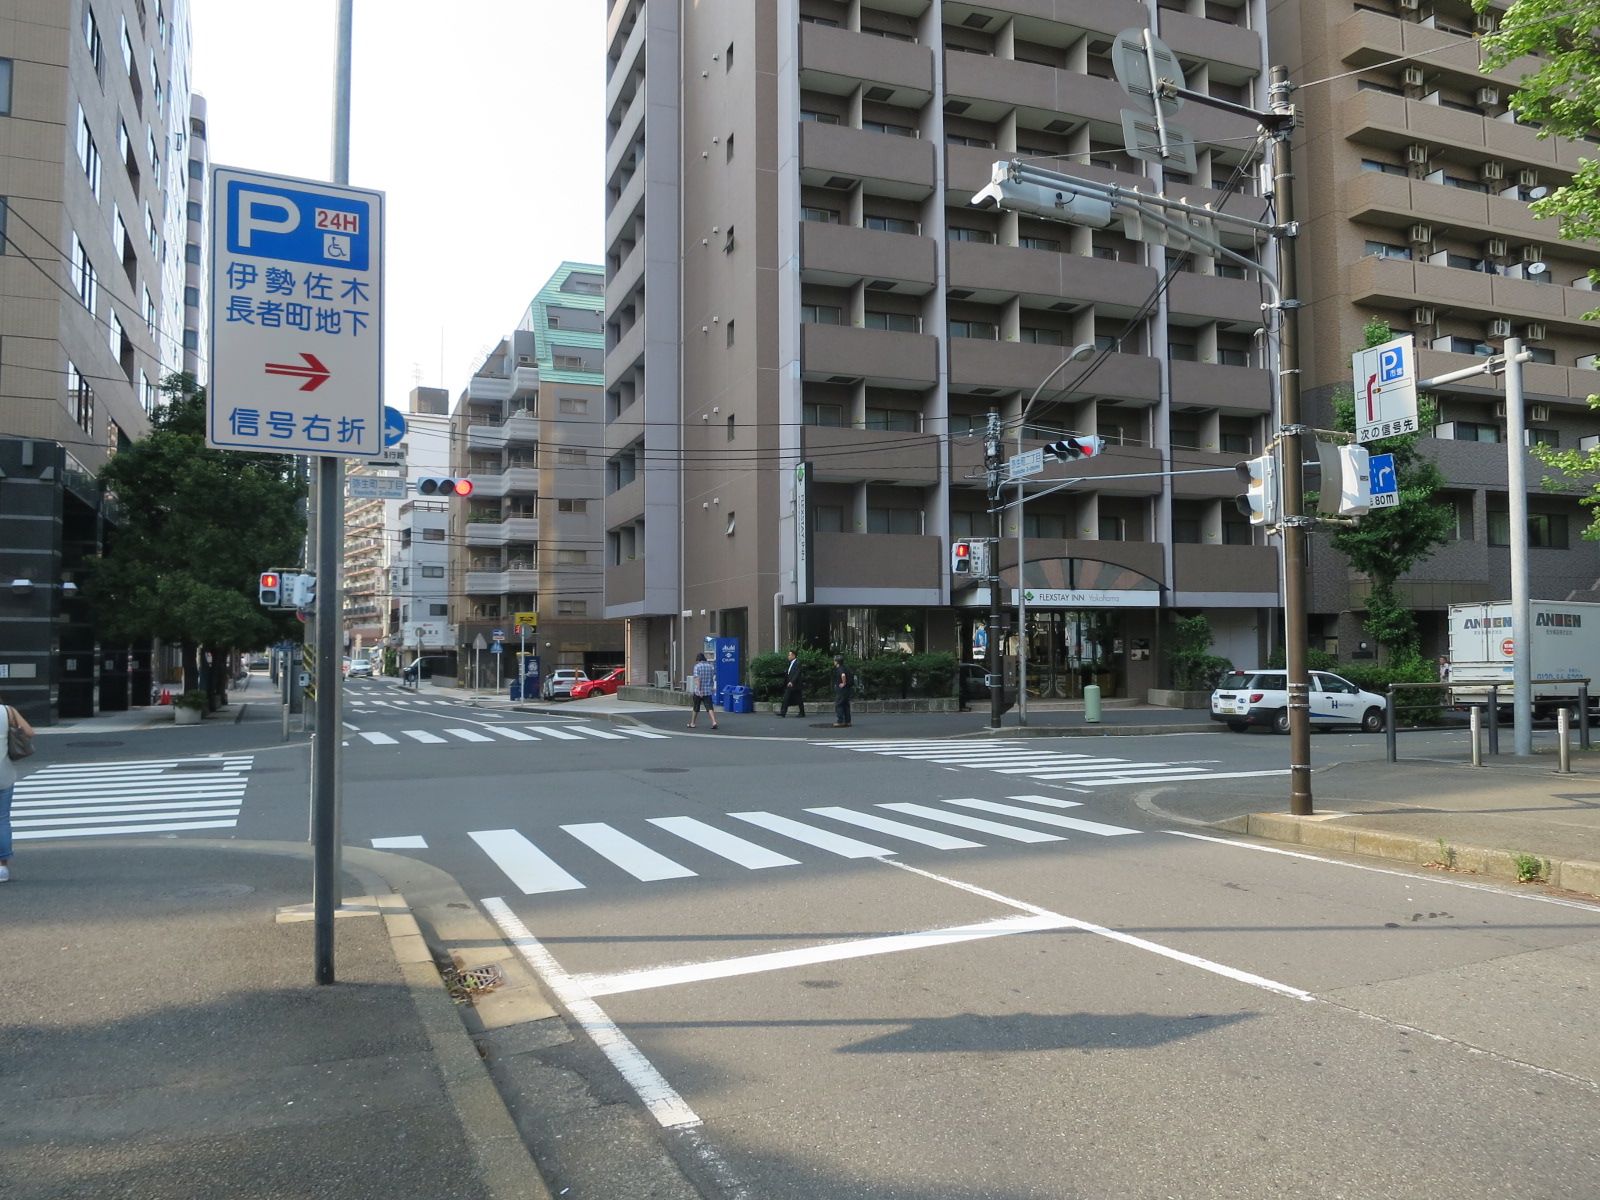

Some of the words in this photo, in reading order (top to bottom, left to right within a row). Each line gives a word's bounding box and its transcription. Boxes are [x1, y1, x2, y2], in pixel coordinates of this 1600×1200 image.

[237, 188, 301, 248] P
[316, 209, 358, 233] 24H
[226, 261, 370, 304] 伊勢佐木
[225, 295, 370, 337] 長者町地下
[1382, 351, 1398, 381] P
[228, 407, 366, 445] 信号右折
[1360, 419, 1414, 441] 次の信号先
[1375, 494, 1394, 506] 80m
[1039, 593, 1069, 601] FLEXSTAY
[1071, 593, 1085, 601] INN
